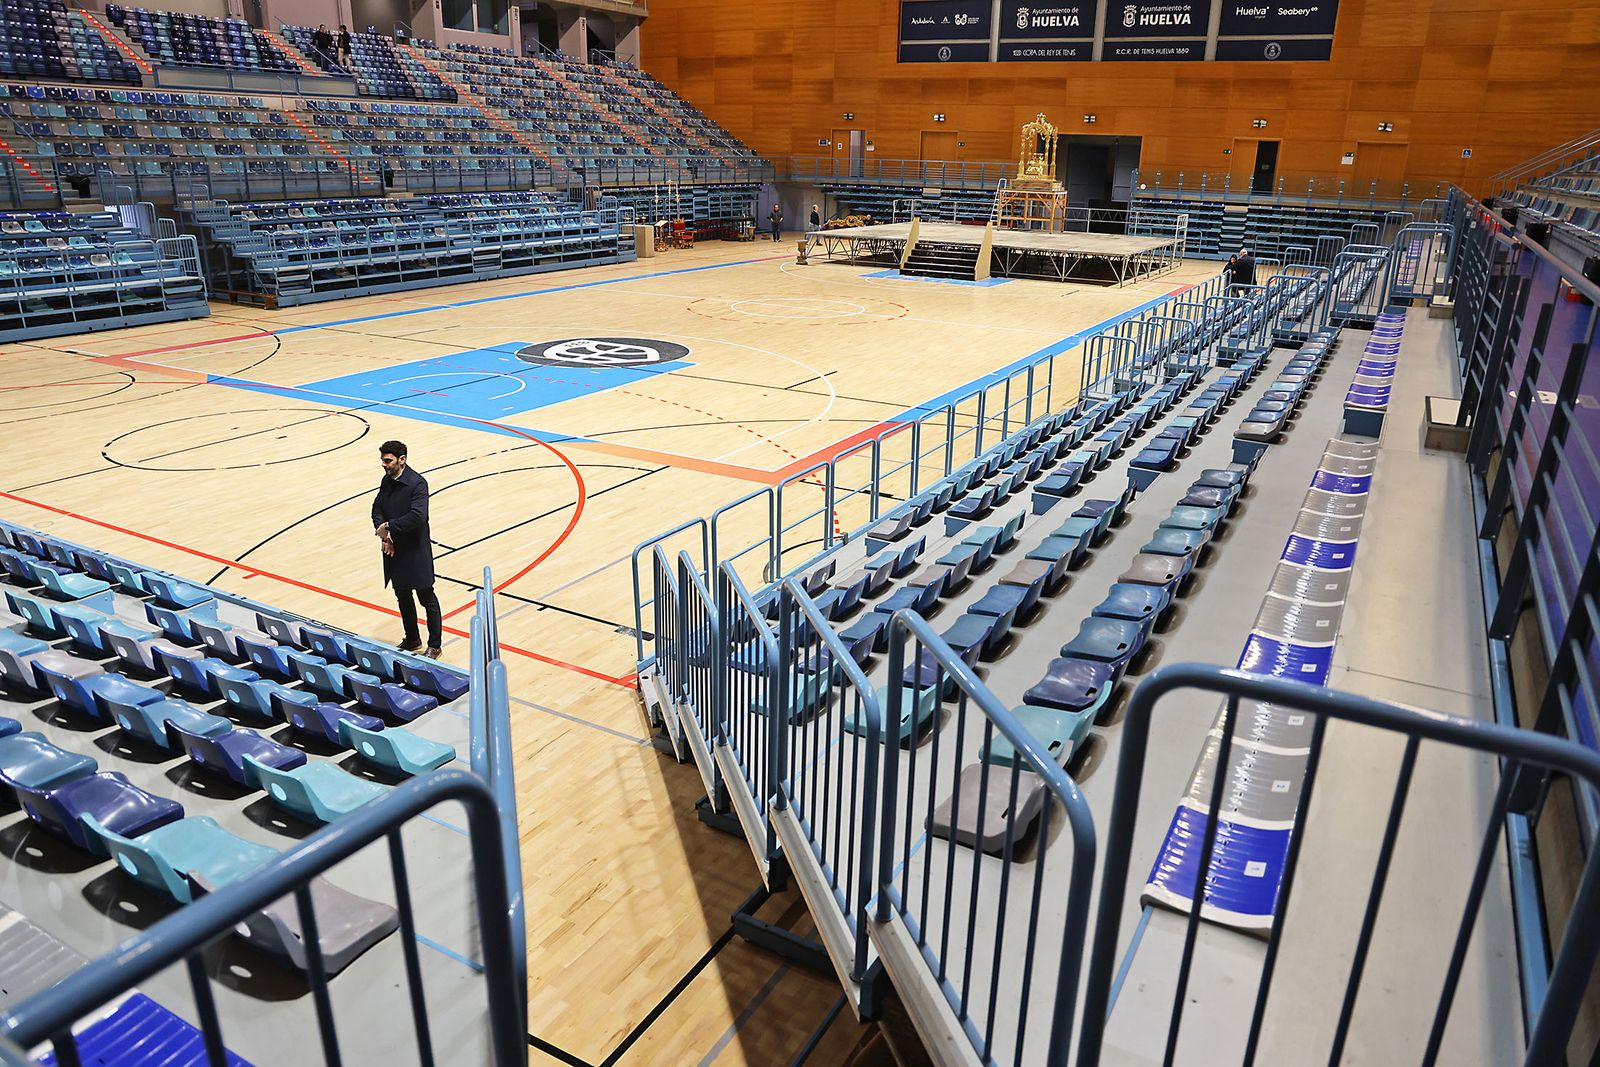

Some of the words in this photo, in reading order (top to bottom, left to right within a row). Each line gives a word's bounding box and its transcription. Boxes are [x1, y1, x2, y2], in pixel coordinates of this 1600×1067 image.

[1140, 5, 1182, 13] Ayuntamiento
[1236, 6, 1266, 16] Huelva
[1278, 8, 1310, 16] Seabery
[1032, 16, 1080, 27] HUELVA
[1140, 14, 1191, 26] HUELVA
